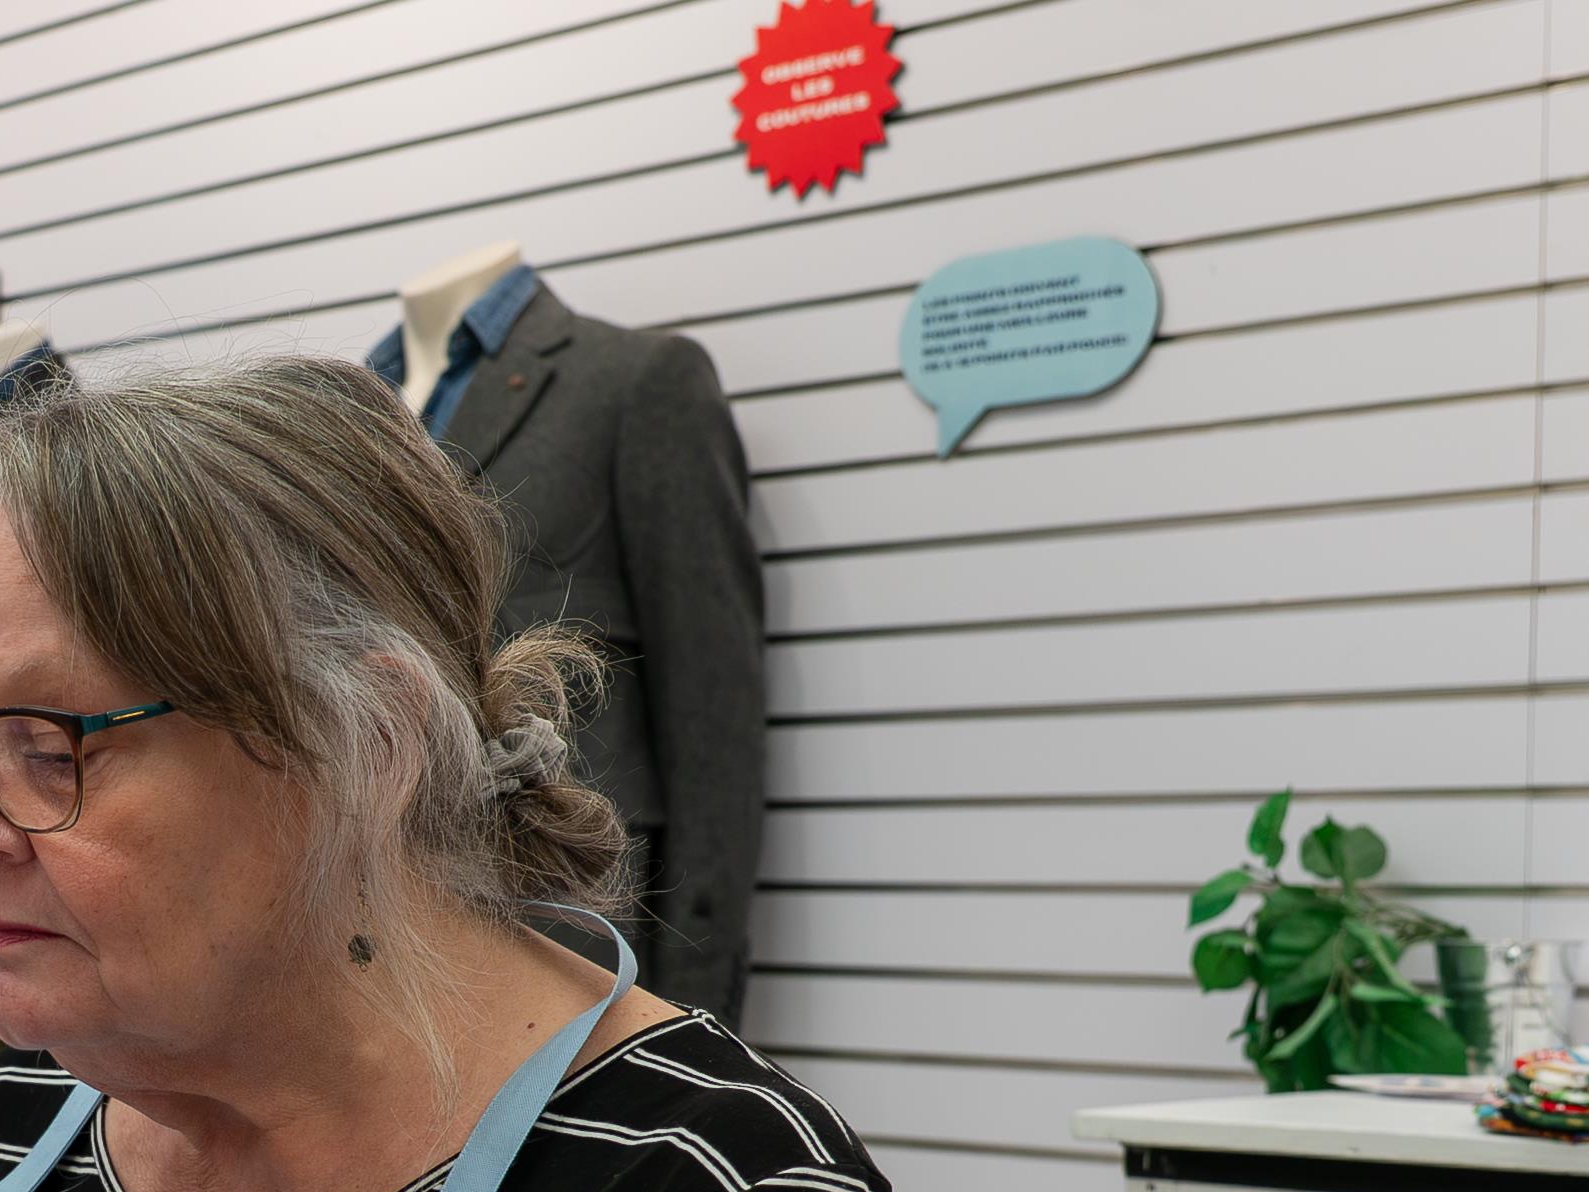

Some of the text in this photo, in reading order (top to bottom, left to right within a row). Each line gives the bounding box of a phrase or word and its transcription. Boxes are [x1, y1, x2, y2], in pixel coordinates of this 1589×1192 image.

[761, 45, 865, 86] OBSERVE
[790, 74, 835, 103] LES
[755, 90, 871, 133] COUTURES
